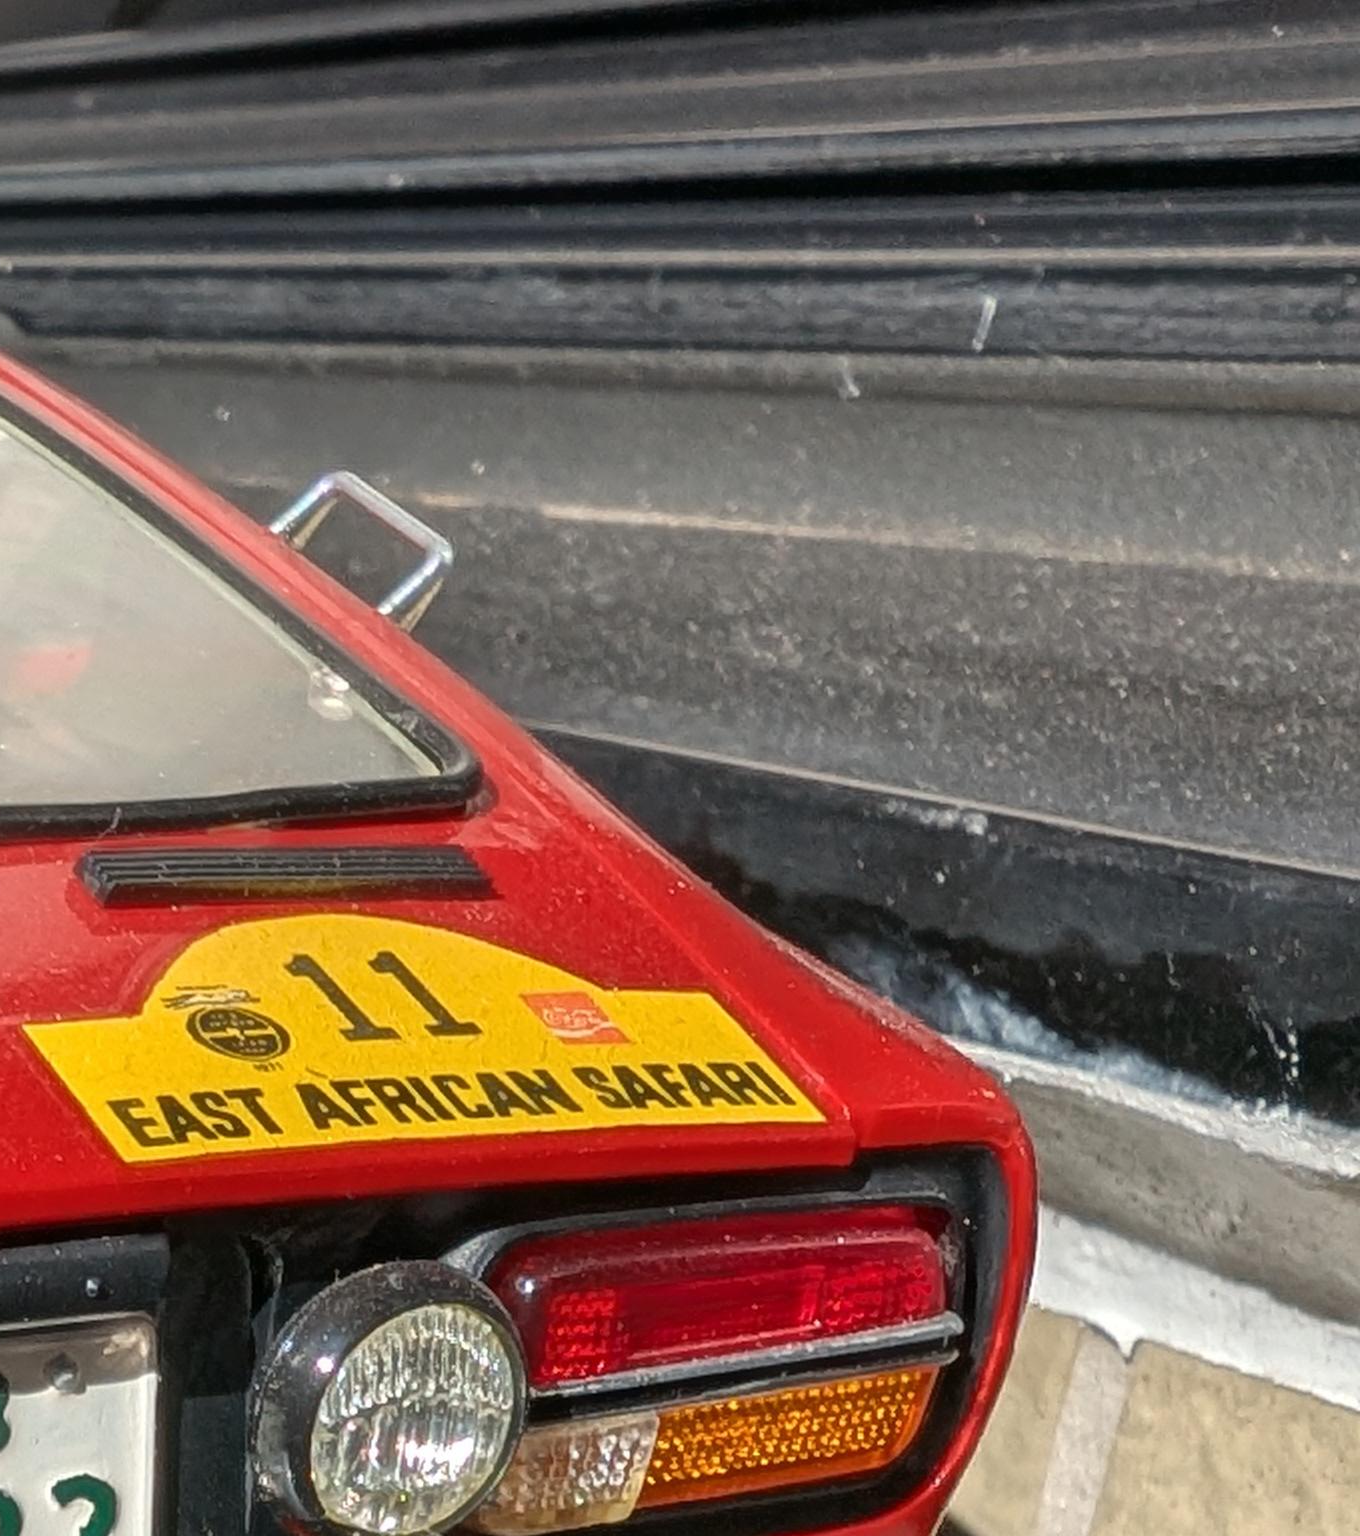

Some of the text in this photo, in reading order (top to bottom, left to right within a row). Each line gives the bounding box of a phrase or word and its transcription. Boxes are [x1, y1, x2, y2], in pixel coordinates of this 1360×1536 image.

[283, 949, 484, 1042] 11
[107, 1060, 798, 1148] EAST AFRICAN SAFARI
